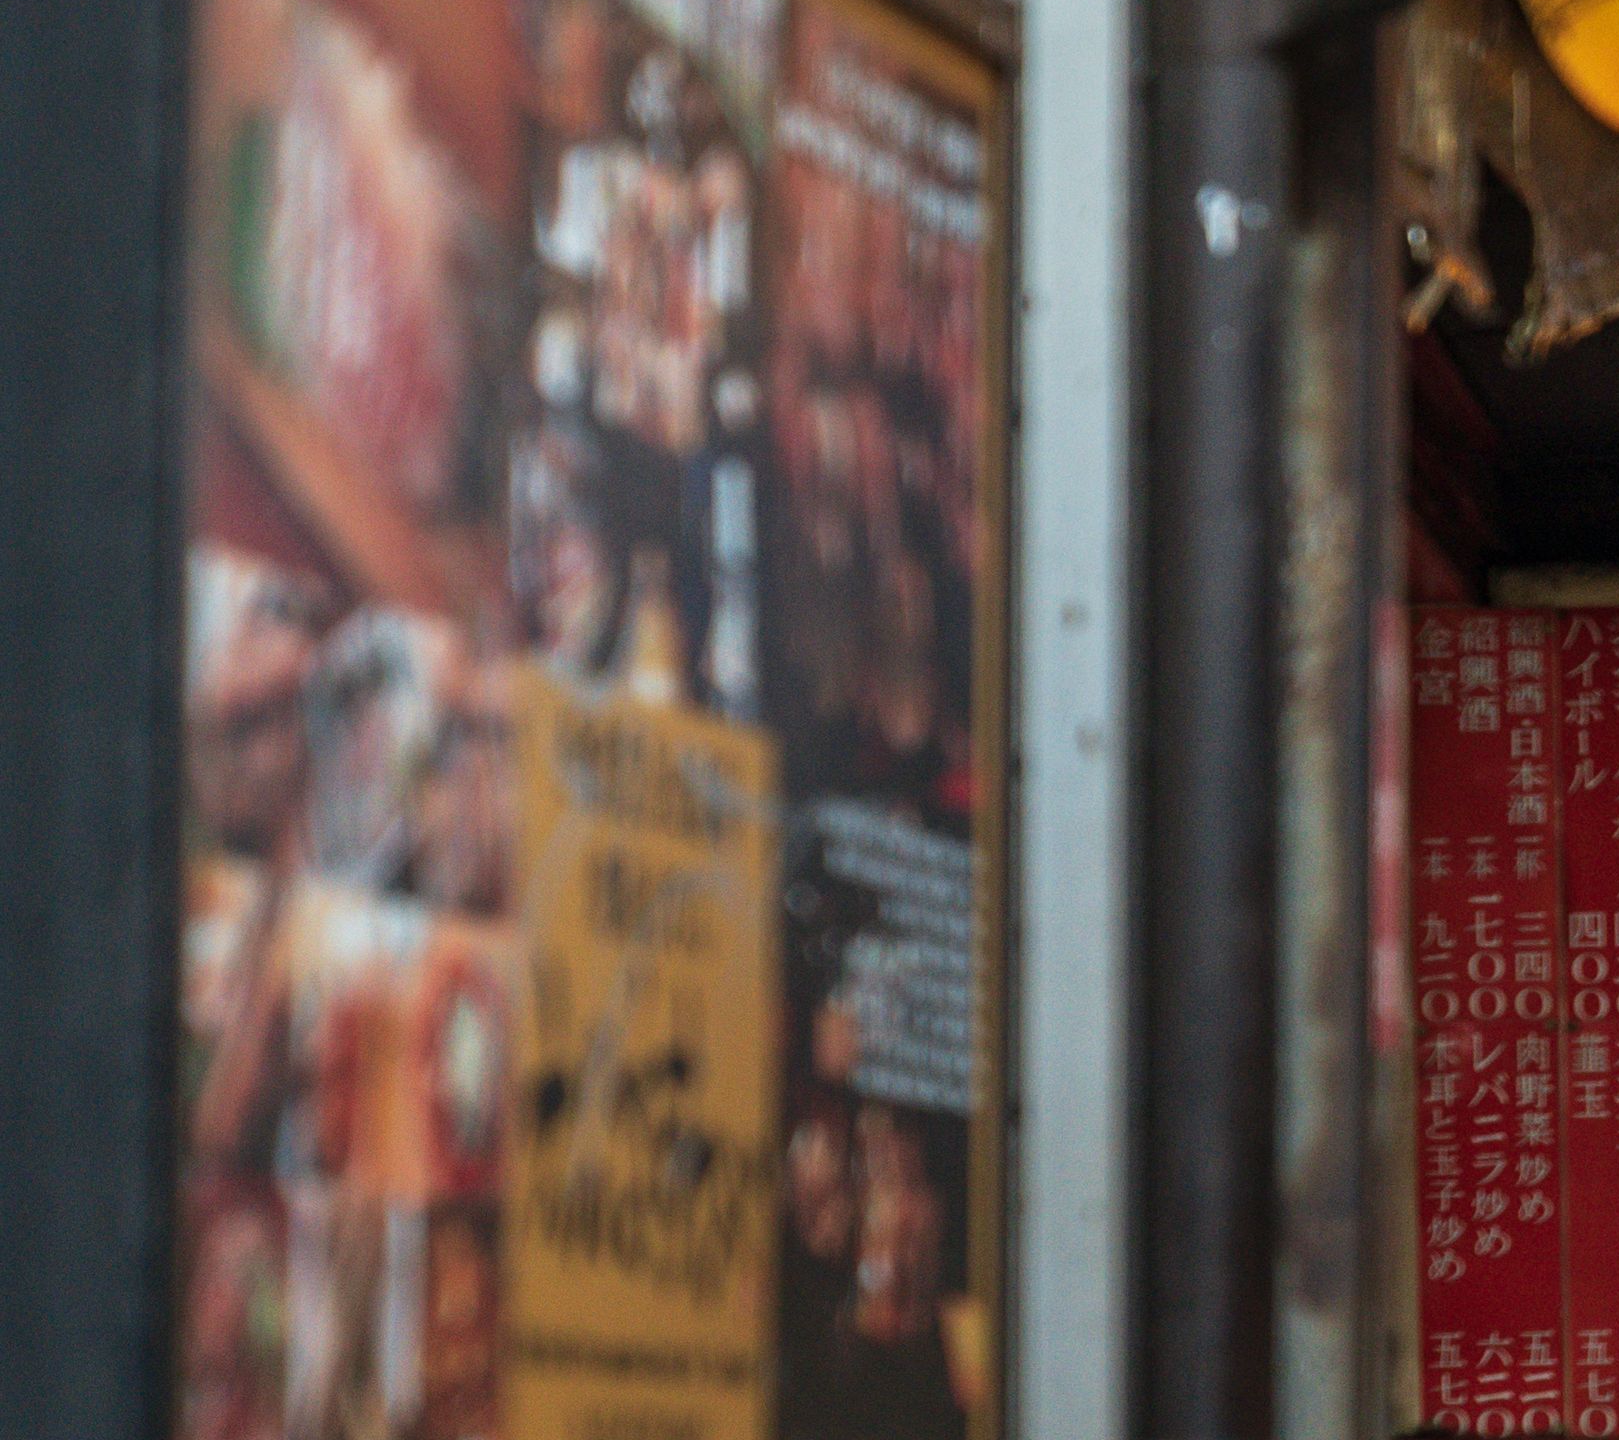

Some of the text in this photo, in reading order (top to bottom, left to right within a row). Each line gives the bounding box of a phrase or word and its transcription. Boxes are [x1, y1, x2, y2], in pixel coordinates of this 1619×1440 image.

[1415, 615, 1457, 706] 金宮
[1457, 616, 1499, 733] 紹興酒
[1561, 614, 1610, 795] ハイボール
[1420, 835, 1451, 882] 一本
[1465, 834, 1497, 882] 一本
[1422, 1032, 1468, 1283] 木耳と玉子炒め
[1466, 1031, 1512, 1258] レバニラ炒め
[1515, 1030, 1555, 1225] 肉野菜炒め
